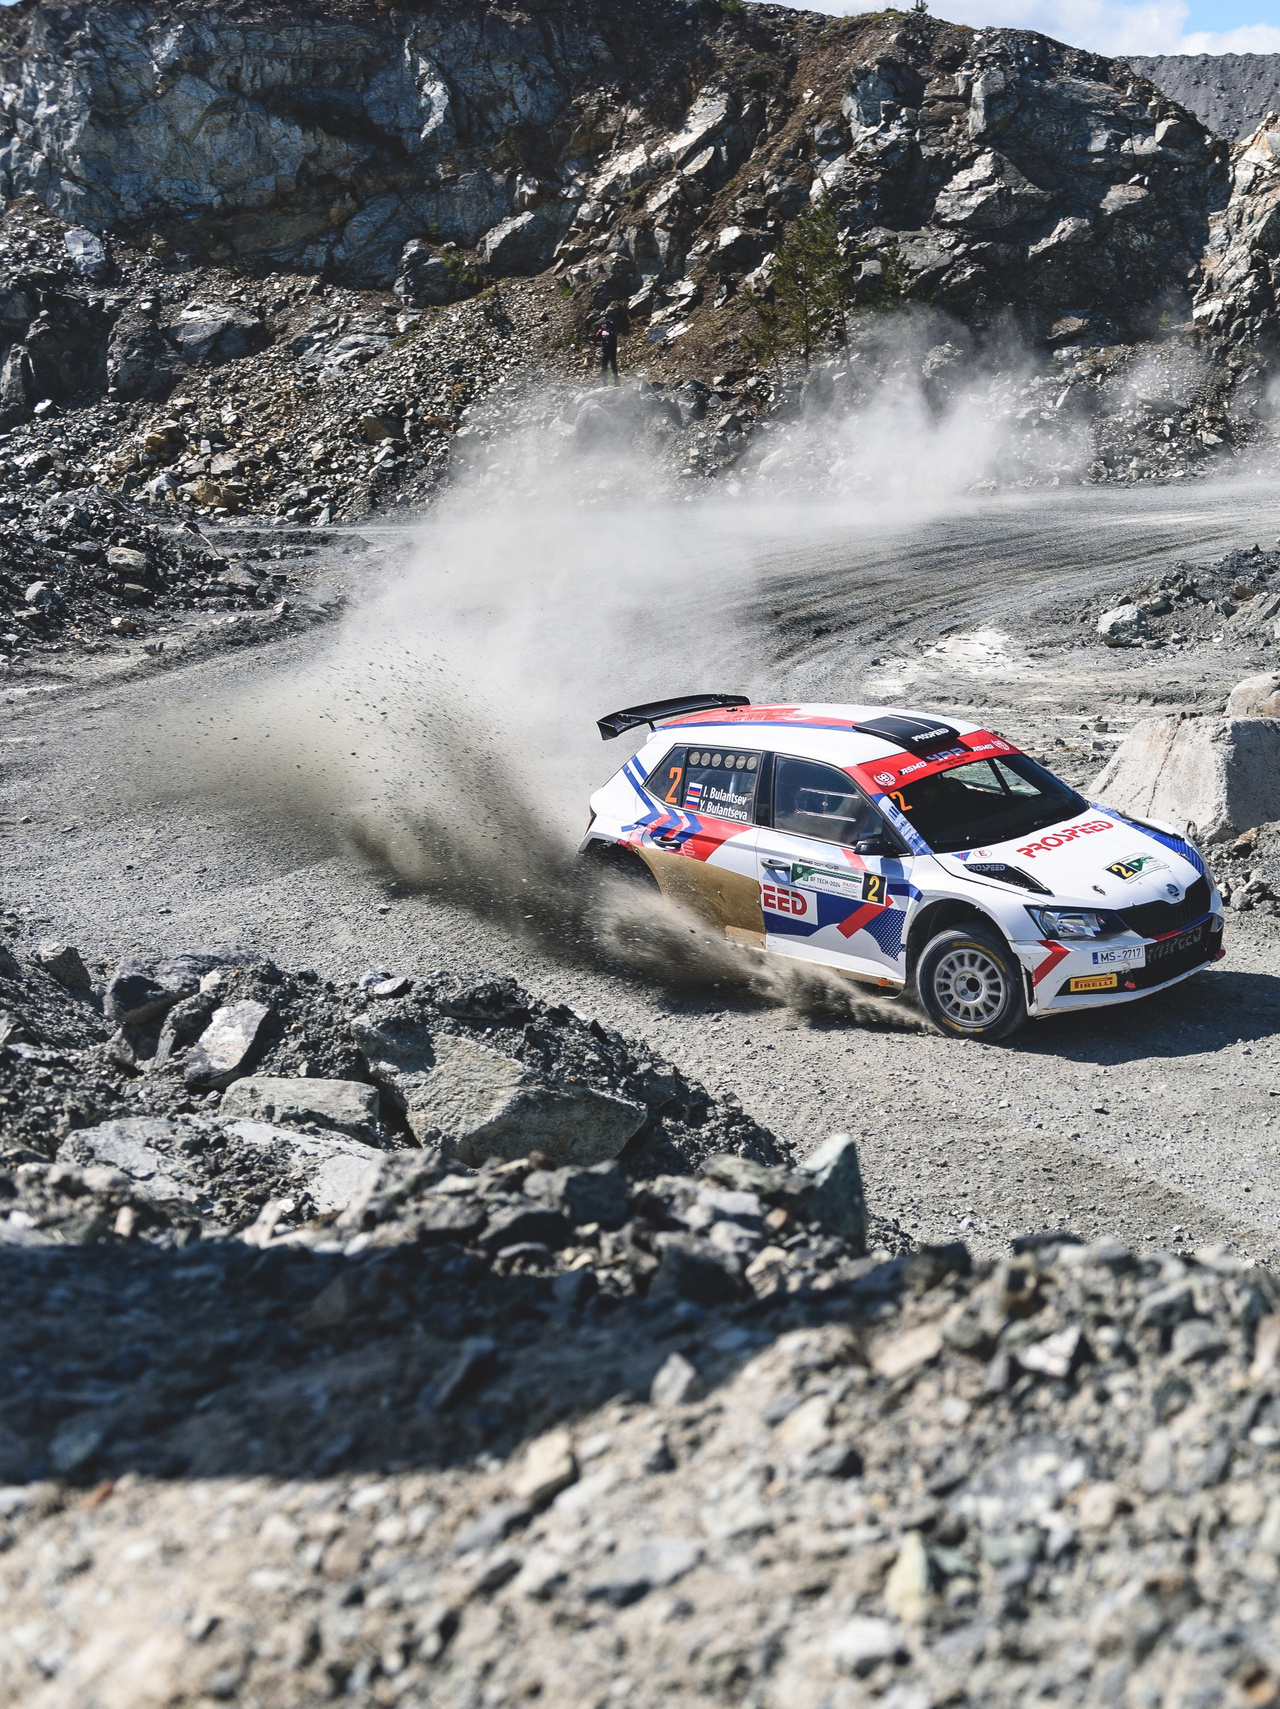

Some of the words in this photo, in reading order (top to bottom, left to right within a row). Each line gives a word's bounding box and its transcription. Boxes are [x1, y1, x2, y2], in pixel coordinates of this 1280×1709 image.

[664, 766, 683, 803] 2
[702, 785, 708, 798] I.
[709, 787, 748, 806] Bulantsev
[699, 799, 705, 812] Y.
[706, 801, 748, 821] Bulantseva
[889, 790, 913, 812] 2
[1016, 820, 1114, 859] PROSPEED
[965, 864, 1006, 872] PROSPEED
[1111, 864, 1134, 878] 2
[867, 875, 880, 902] 2
[759, 884, 808, 916] EED
[1074, 976, 1114, 989] PIRELLI
